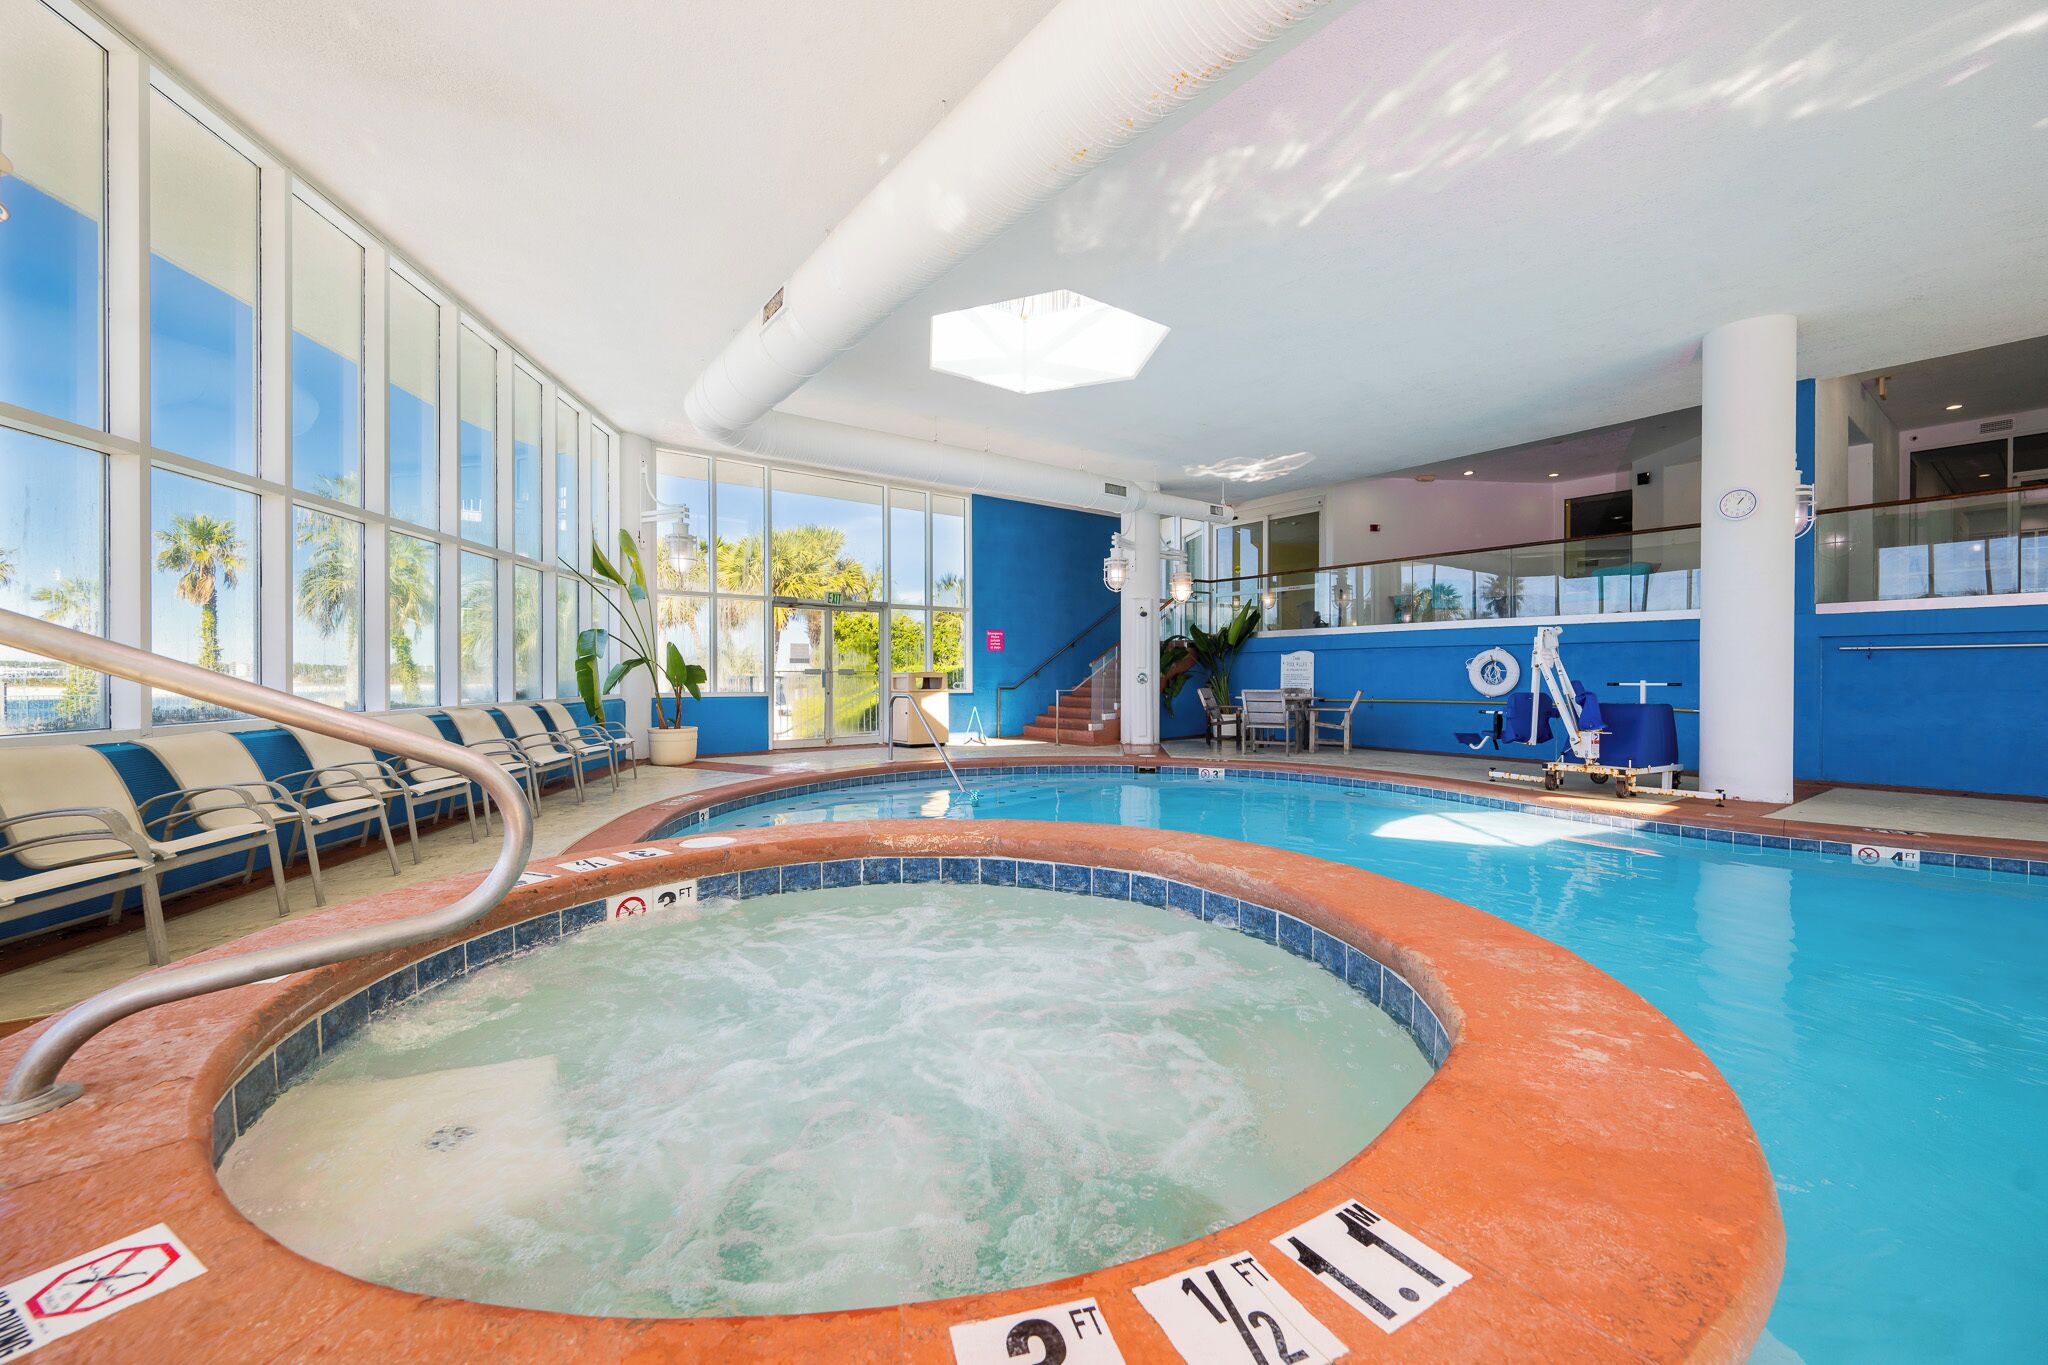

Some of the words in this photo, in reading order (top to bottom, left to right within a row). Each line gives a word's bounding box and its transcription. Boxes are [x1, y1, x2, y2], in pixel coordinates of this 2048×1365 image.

[828, 592, 842, 605] EXIT
[679, 886, 693, 899] FT
[1342, 1202, 1382, 1228] M
[1230, 1257, 1269, 1287] FT
[1287, 1211, 1447, 1316] 1.1
[1068, 1305, 1103, 1340] FT
